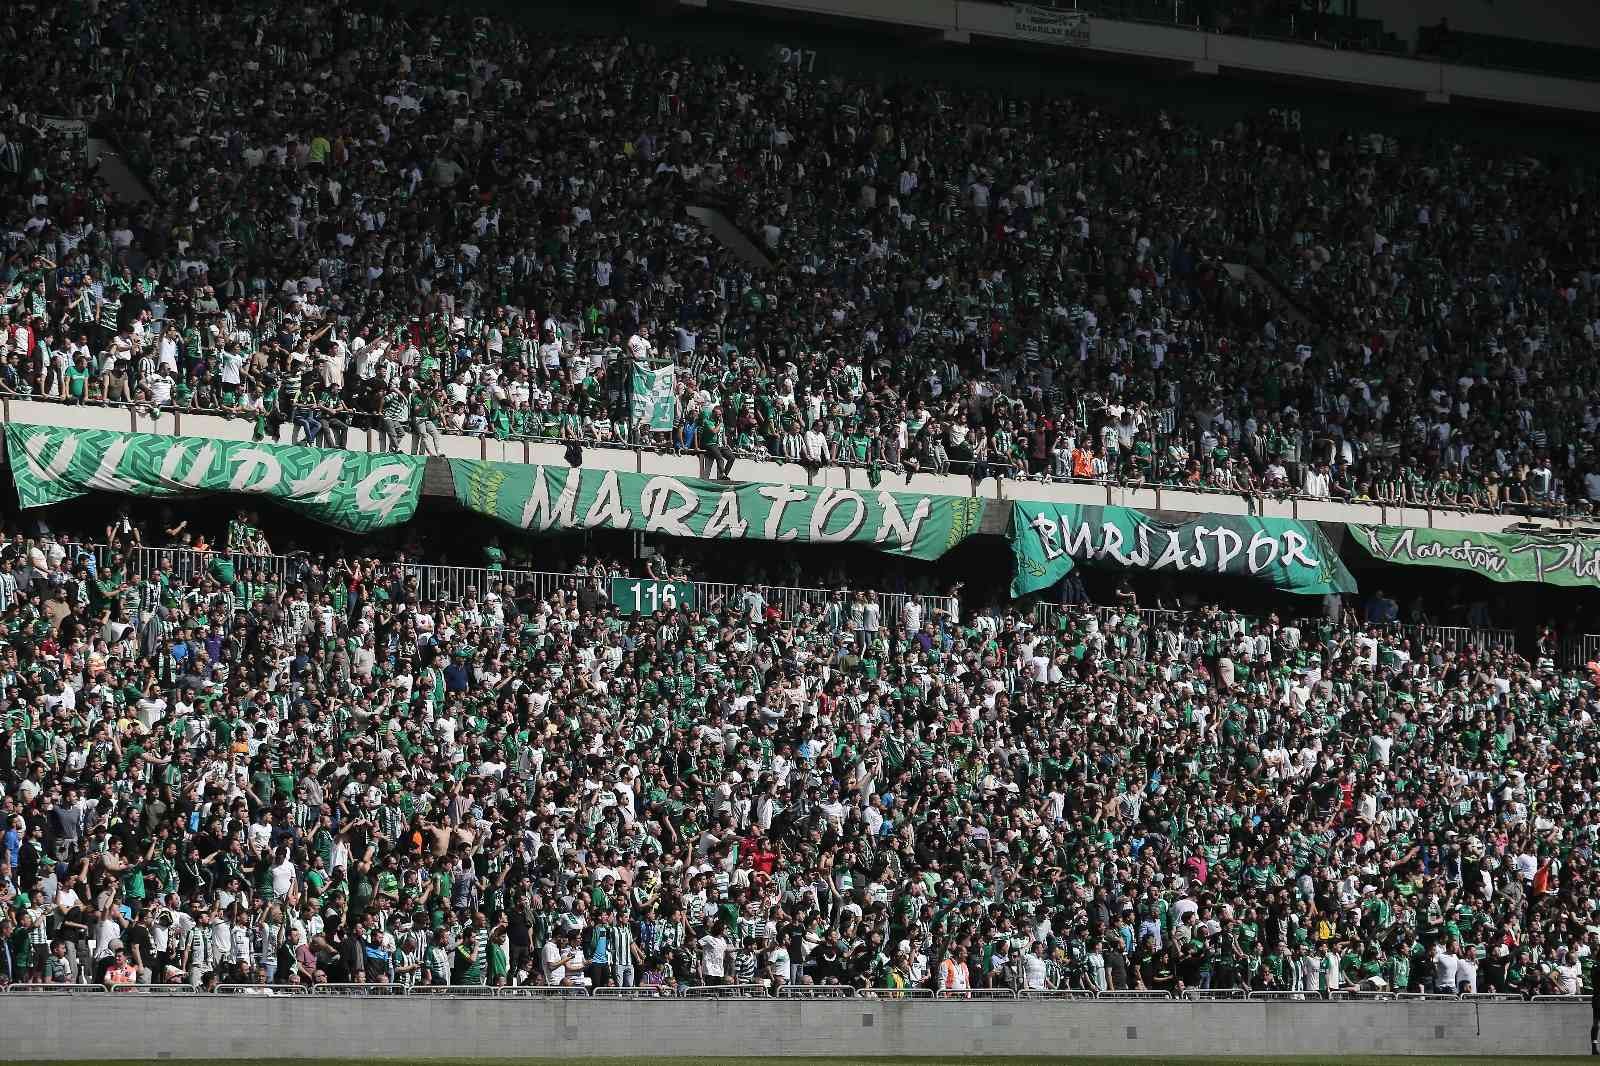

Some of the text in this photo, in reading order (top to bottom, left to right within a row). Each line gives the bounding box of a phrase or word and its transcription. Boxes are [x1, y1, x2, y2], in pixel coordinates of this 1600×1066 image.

[521, 463, 930, 552] MARATON
[1029, 512, 1321, 574] BURSASPOR
[630, 582, 677, 613] 116
